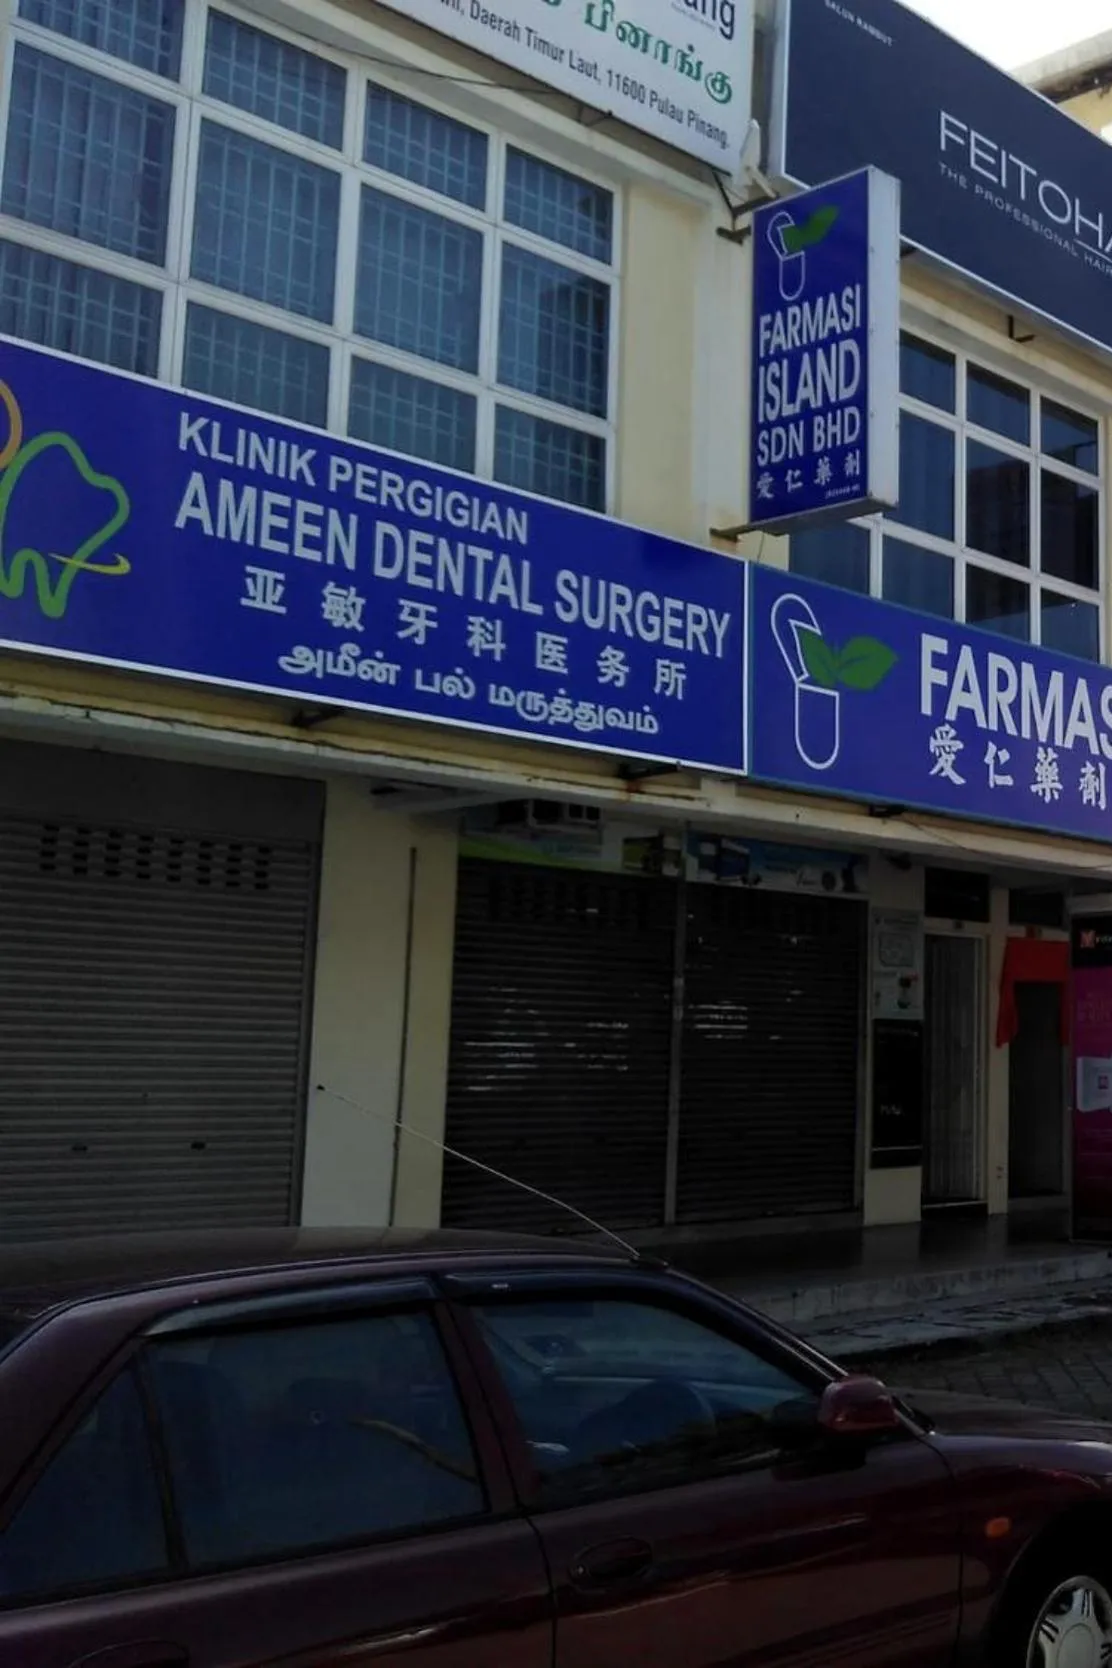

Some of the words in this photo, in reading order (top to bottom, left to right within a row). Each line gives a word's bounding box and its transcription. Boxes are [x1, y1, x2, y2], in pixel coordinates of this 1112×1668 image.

[469, 2, 521, 43] Daerah
[525, 26, 565, 63] Timur
[607, 69, 646, 104] 11600
[649, 90, 684, 124] Pulau
[939, 162, 968, 189] THE
[975, 184, 1078, 257] PROFESSIONAL
[759, 284, 861, 358] FARMASI
[758, 338, 861, 424] ISLAND
[179, 411, 317, 487] KLINIK
[329, 455, 528, 545] PERGIGIAN
[757, 420, 804, 467] SDN
[813, 406, 861, 453] BHD
[174, 471, 358, 571] AMEEN
[374, 520, 543, 616] DENTAL
[555, 569, 731, 658] SURGERY
[240, 565, 687, 700] 亚敏牙科医务所
[278, 642, 401, 686] அமீன்
[415, 666, 476, 700] பல்
[488, 683, 660, 734] மருத்துவம்
